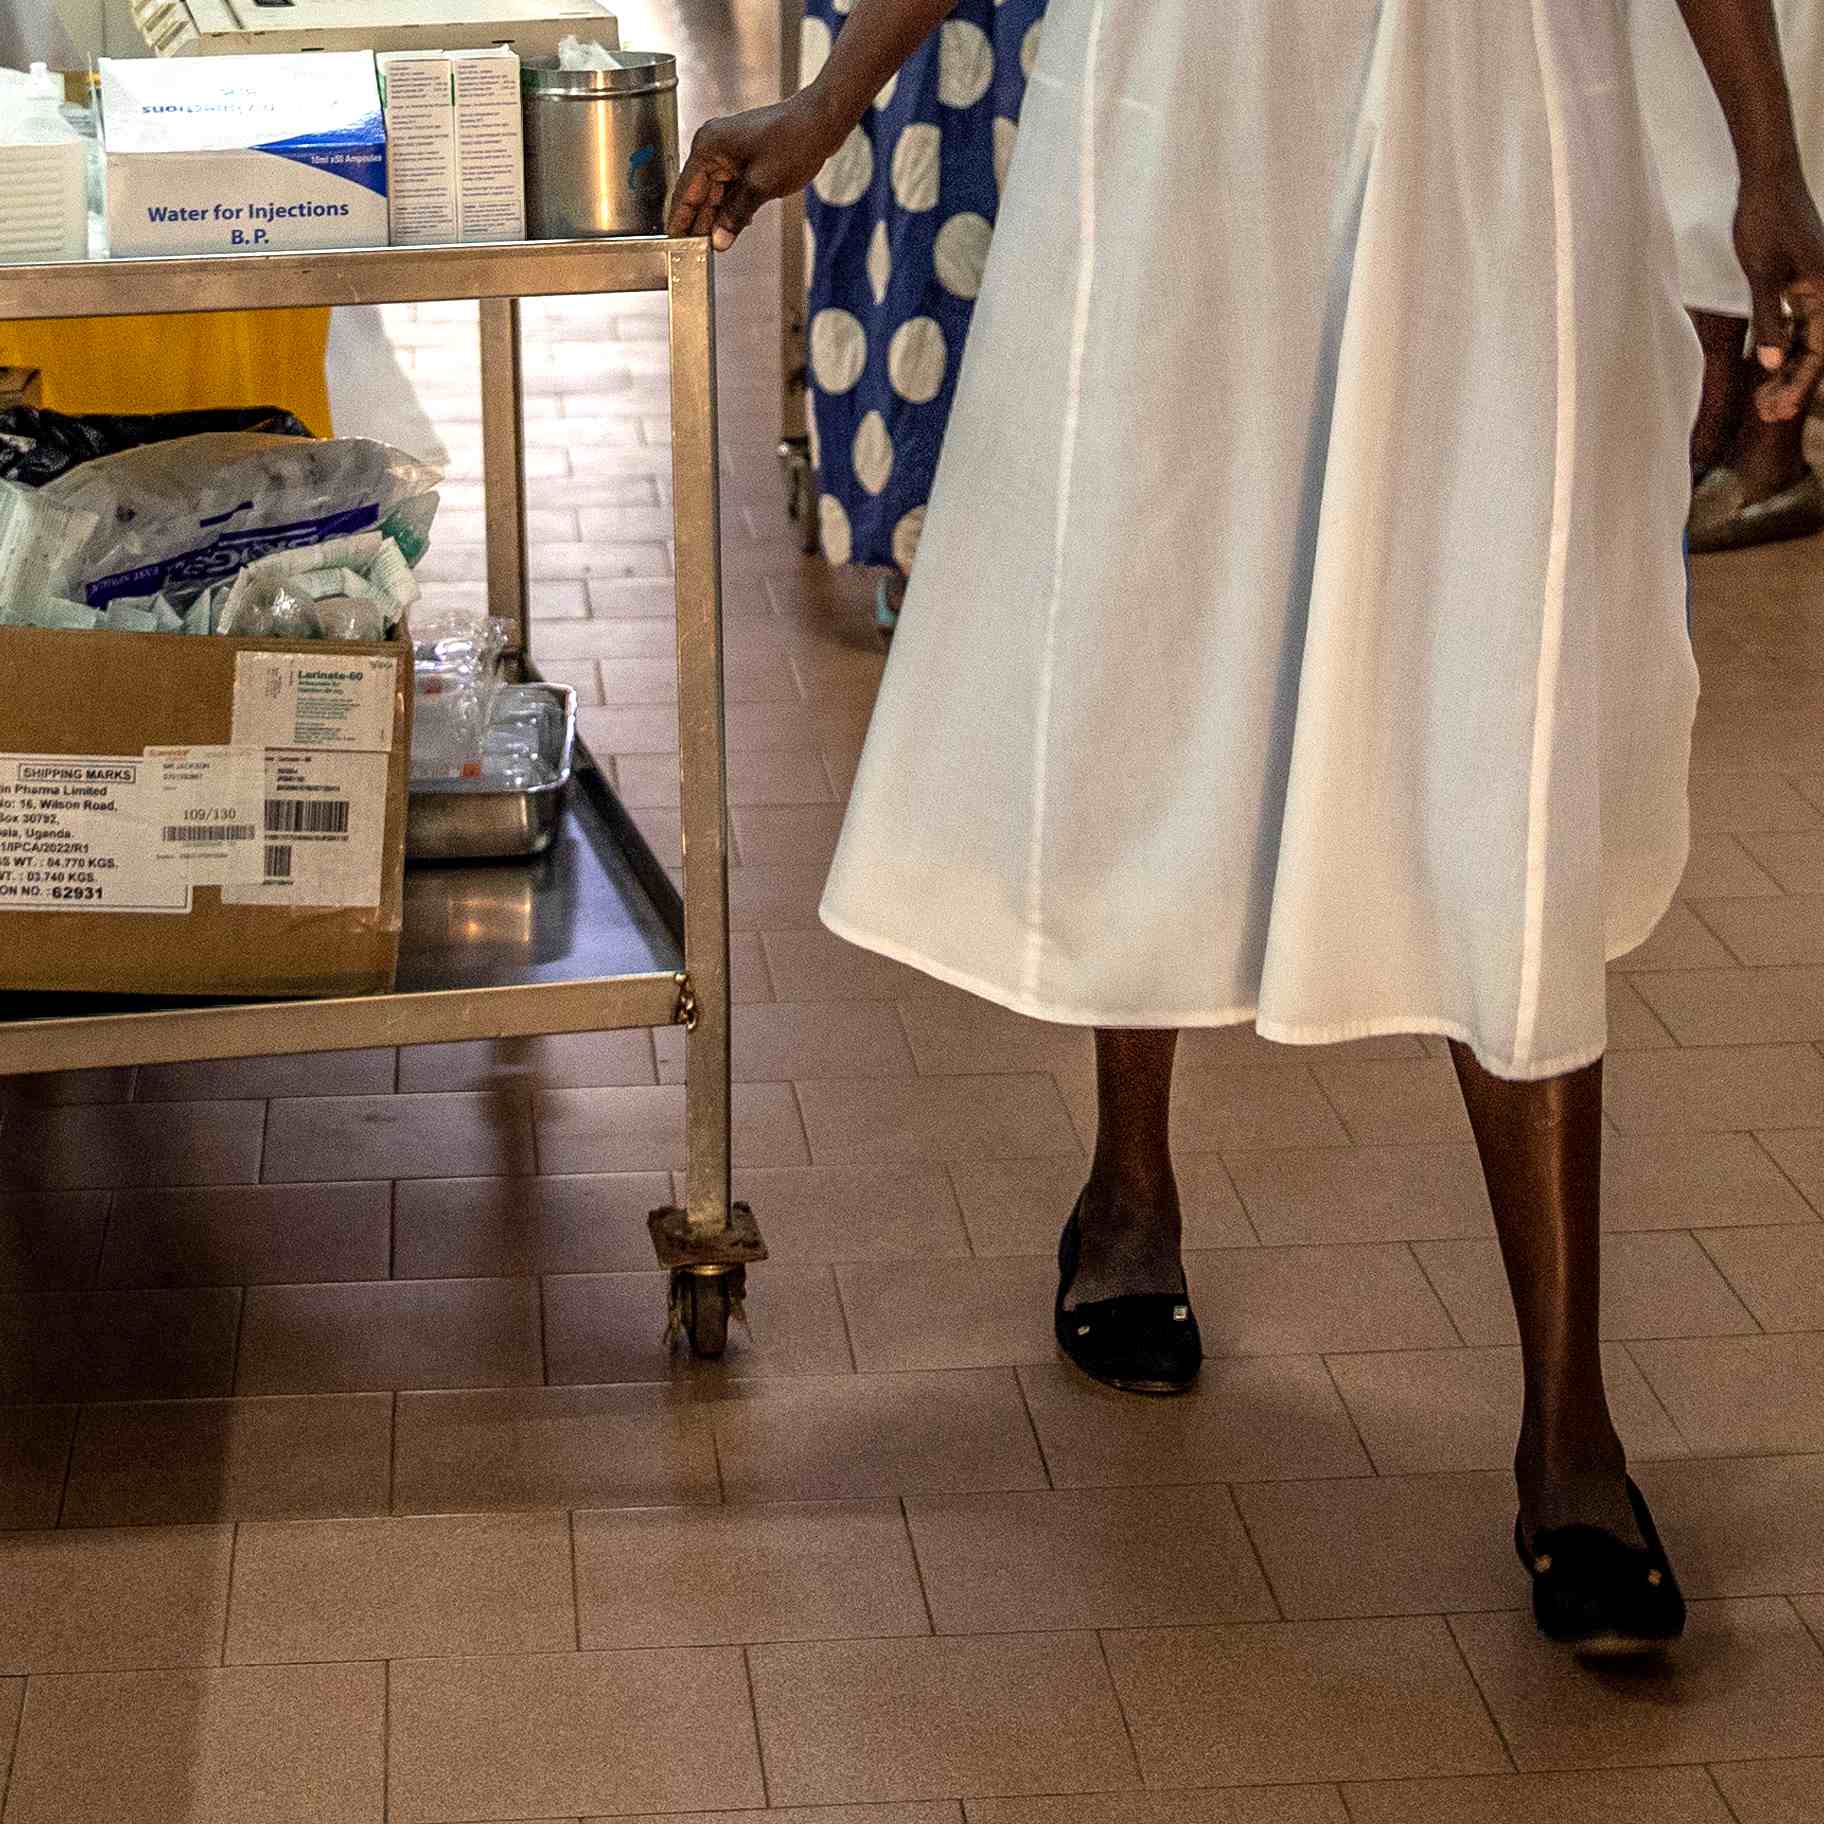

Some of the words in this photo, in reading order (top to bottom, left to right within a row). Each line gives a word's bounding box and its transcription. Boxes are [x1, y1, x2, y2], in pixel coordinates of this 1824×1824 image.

[147, 206, 208, 223] Water
[213, 204, 243, 221] for
[248, 201, 349, 223] Injections
[22, 767, 82, 780] SHIPPING
[85, 768, 132, 781] MARKS
[15, 783, 60, 795] Pharma
[63, 784, 108, 796] Limited
[40, 799, 80, 810] Wilson
[182, 807, 237, 822] 109/130
[52, 886, 104, 899] 62931
